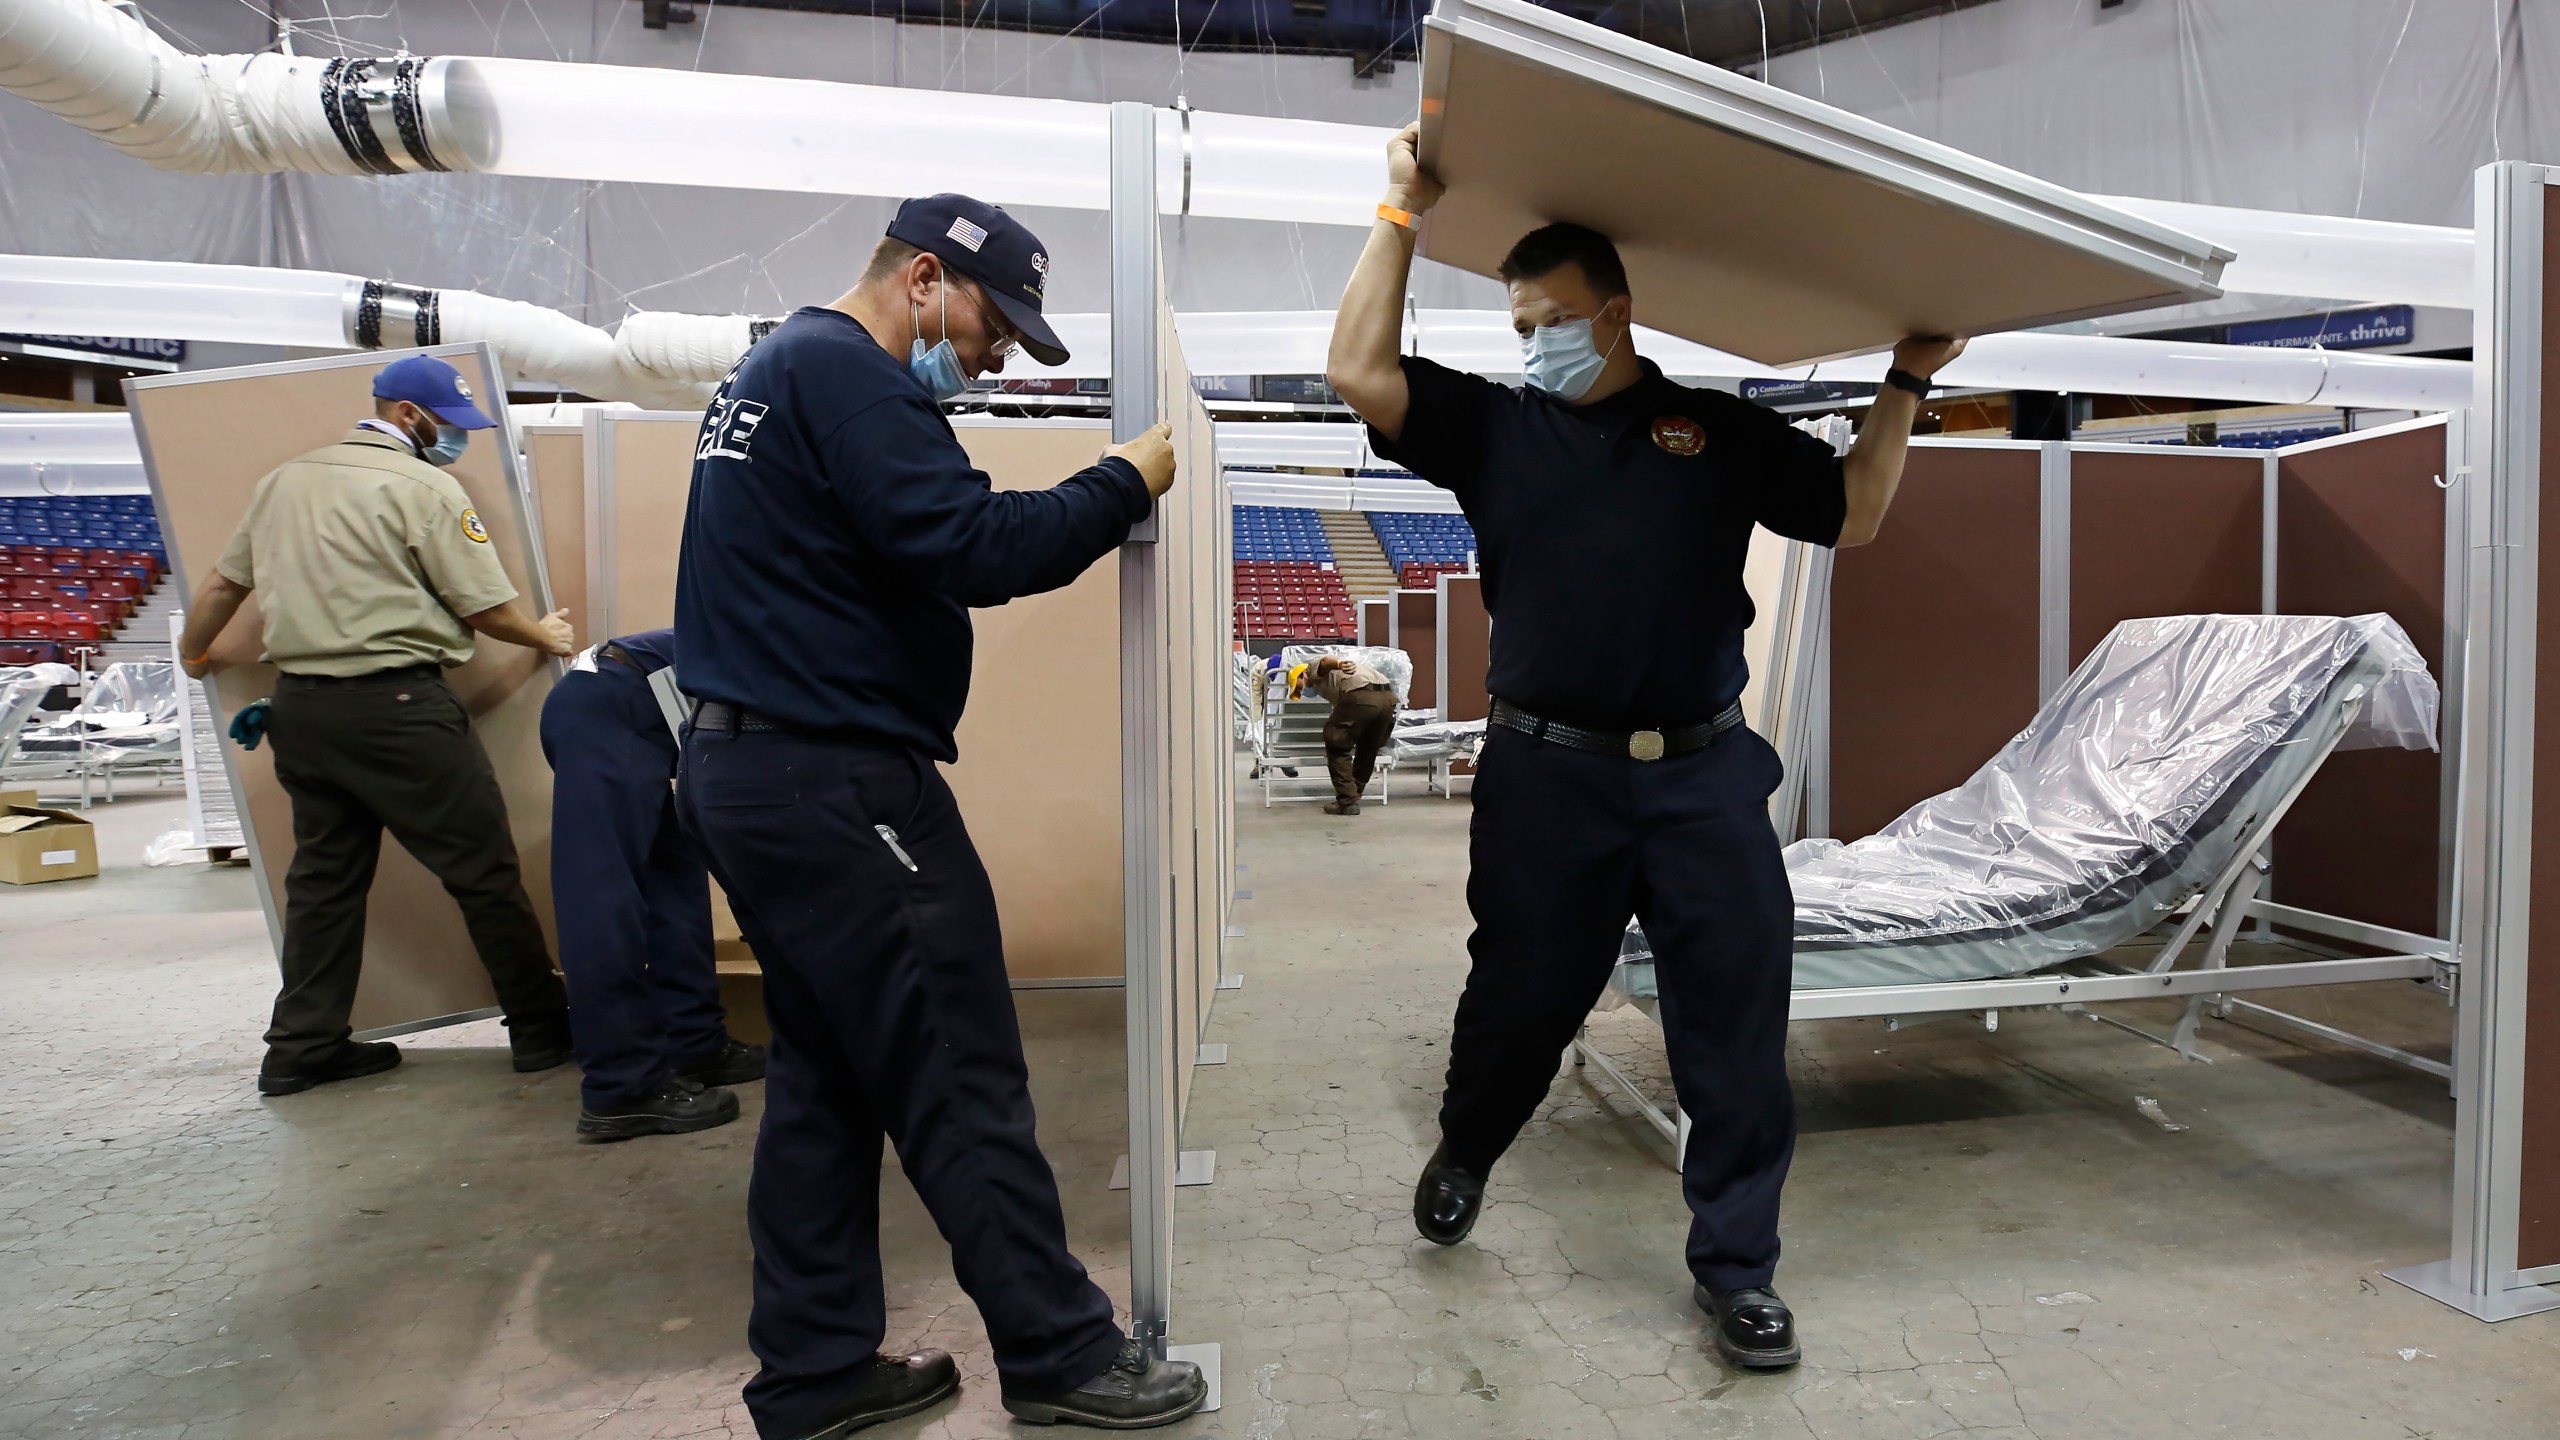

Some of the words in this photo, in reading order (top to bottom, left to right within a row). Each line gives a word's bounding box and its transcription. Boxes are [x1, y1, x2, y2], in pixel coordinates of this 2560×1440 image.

[2274, 332, 2344, 348] PERMANENTE
[2350, 323, 2406, 341] thrive
[1196, 375, 1227, 391] nk
[1759, 382, 1805, 393] Consolidated
